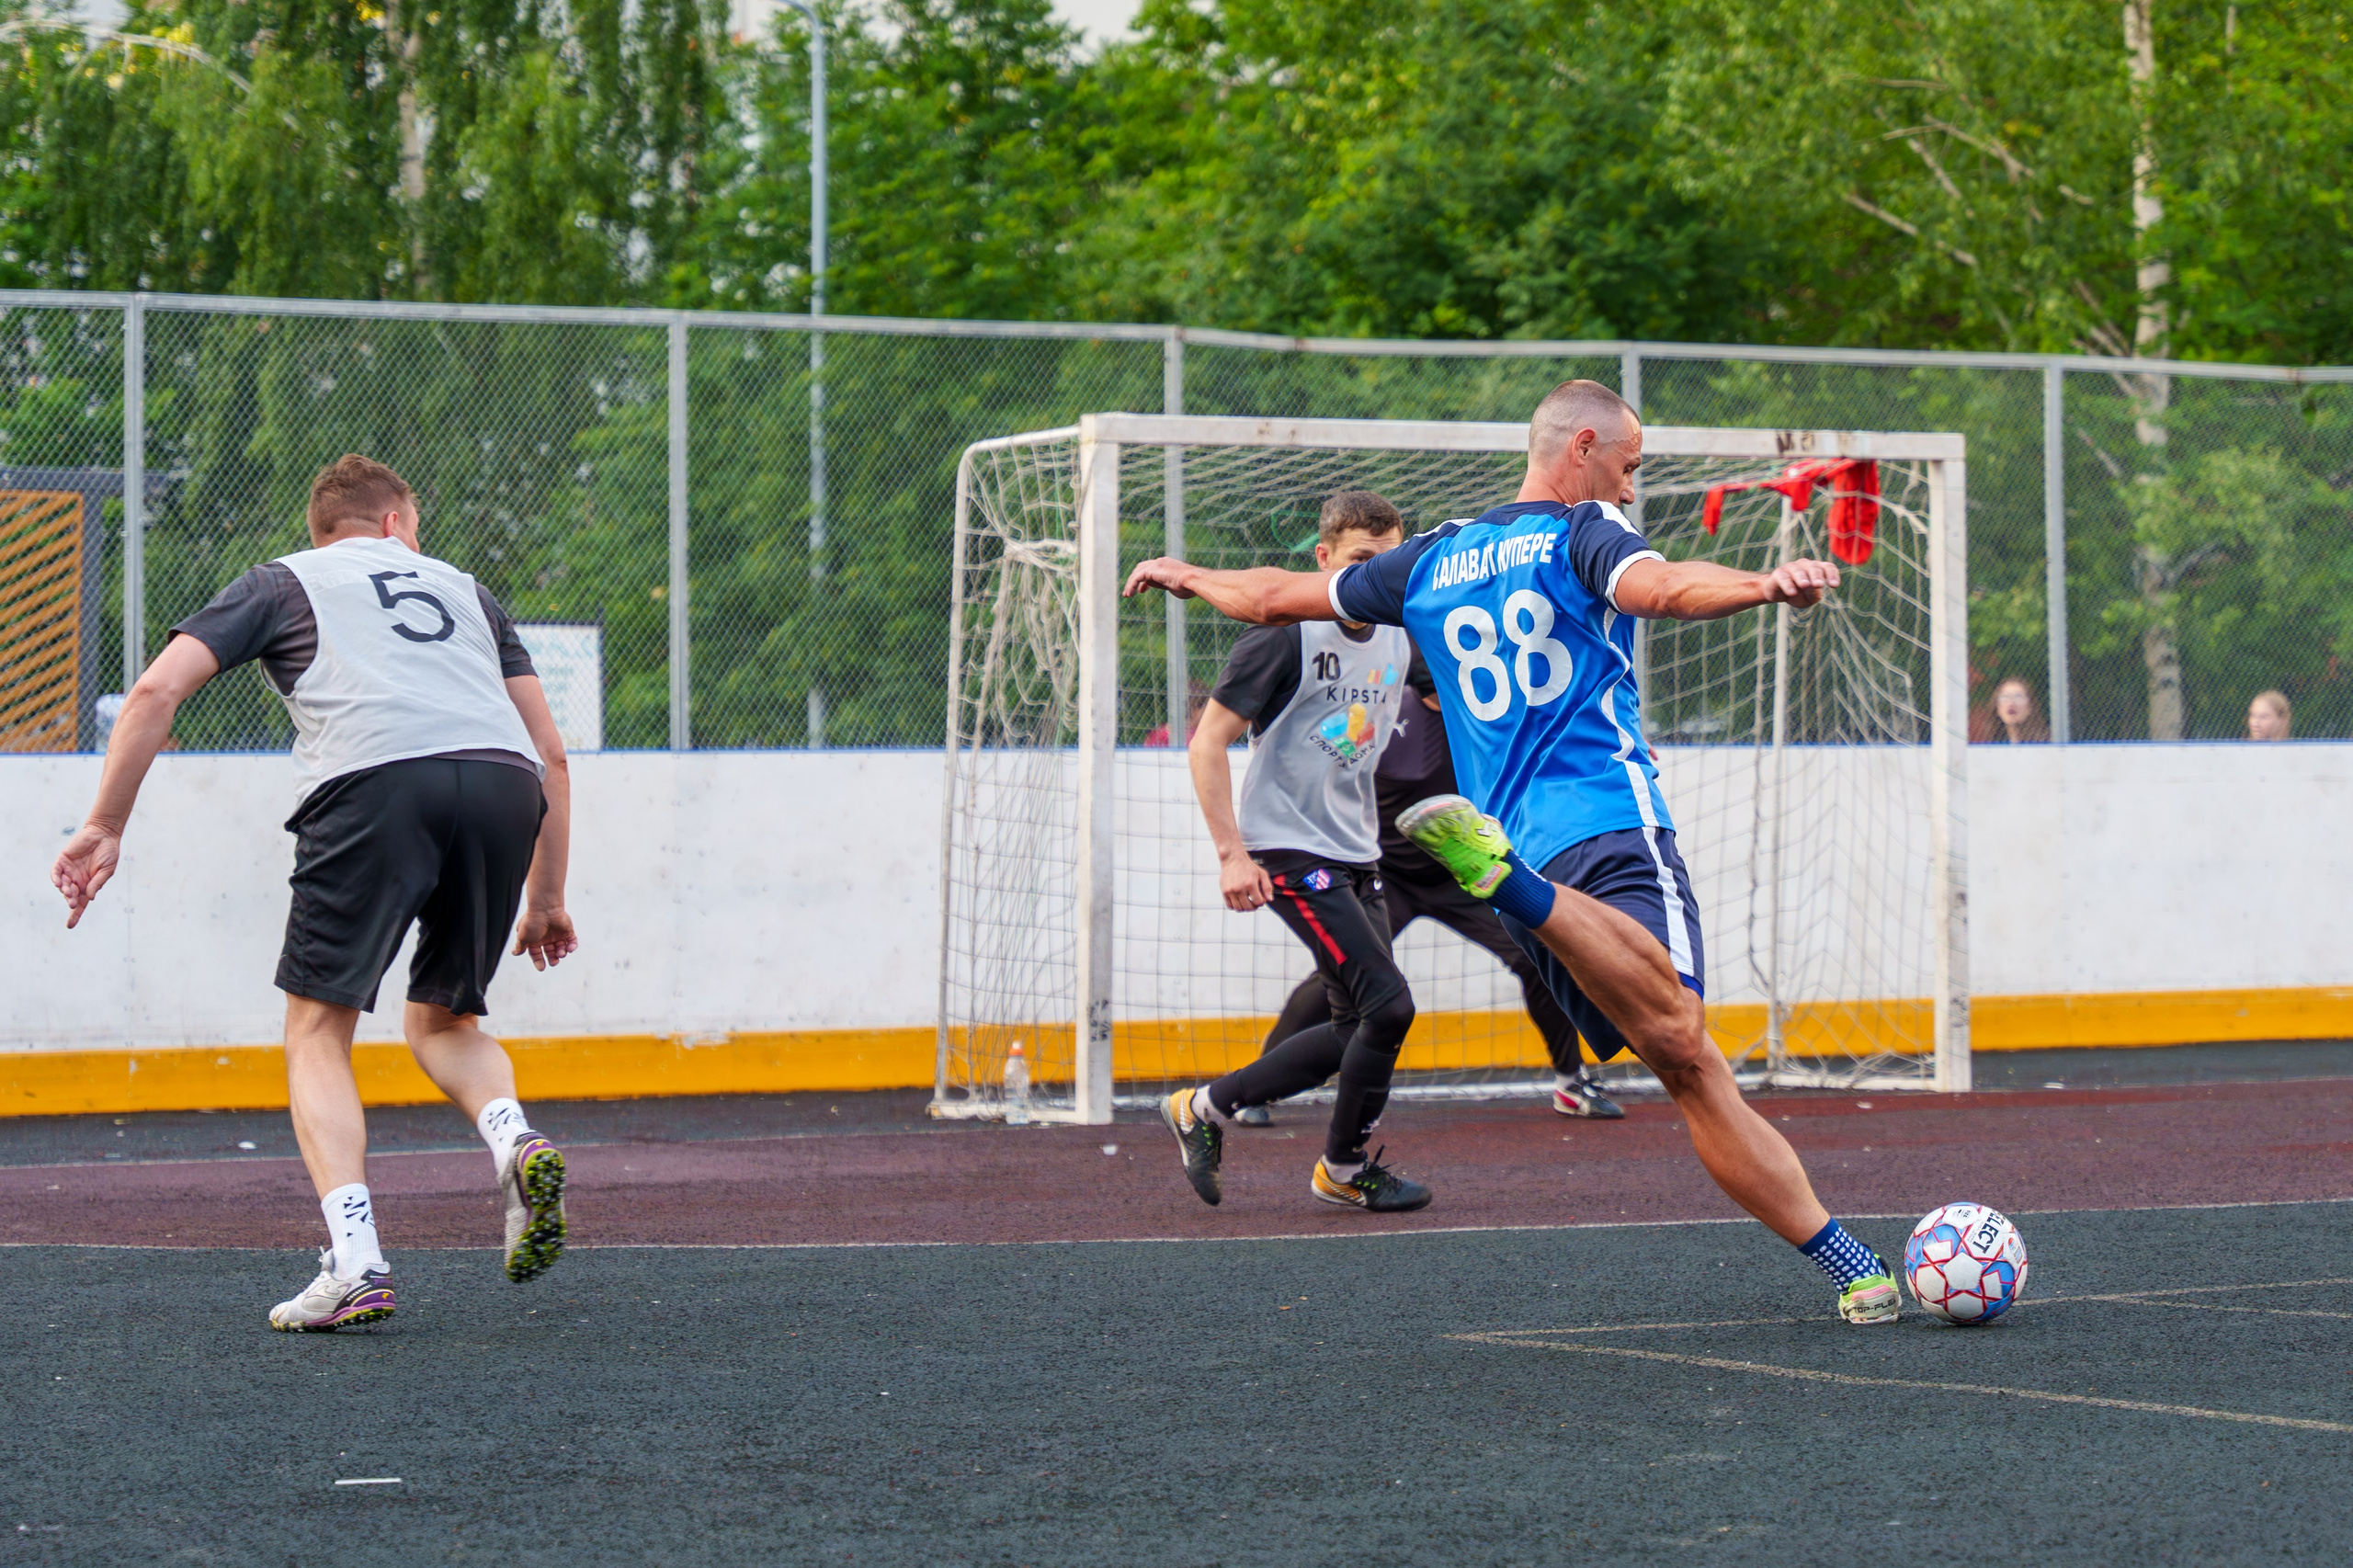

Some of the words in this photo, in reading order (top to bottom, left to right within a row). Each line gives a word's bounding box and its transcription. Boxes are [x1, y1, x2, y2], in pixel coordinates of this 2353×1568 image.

[1497, 532, 1557, 574] КУПЕРЕ
[368, 571, 455, 642] 5
[1312, 652, 1341, 681] 10
[1443, 589, 1574, 722] 88
